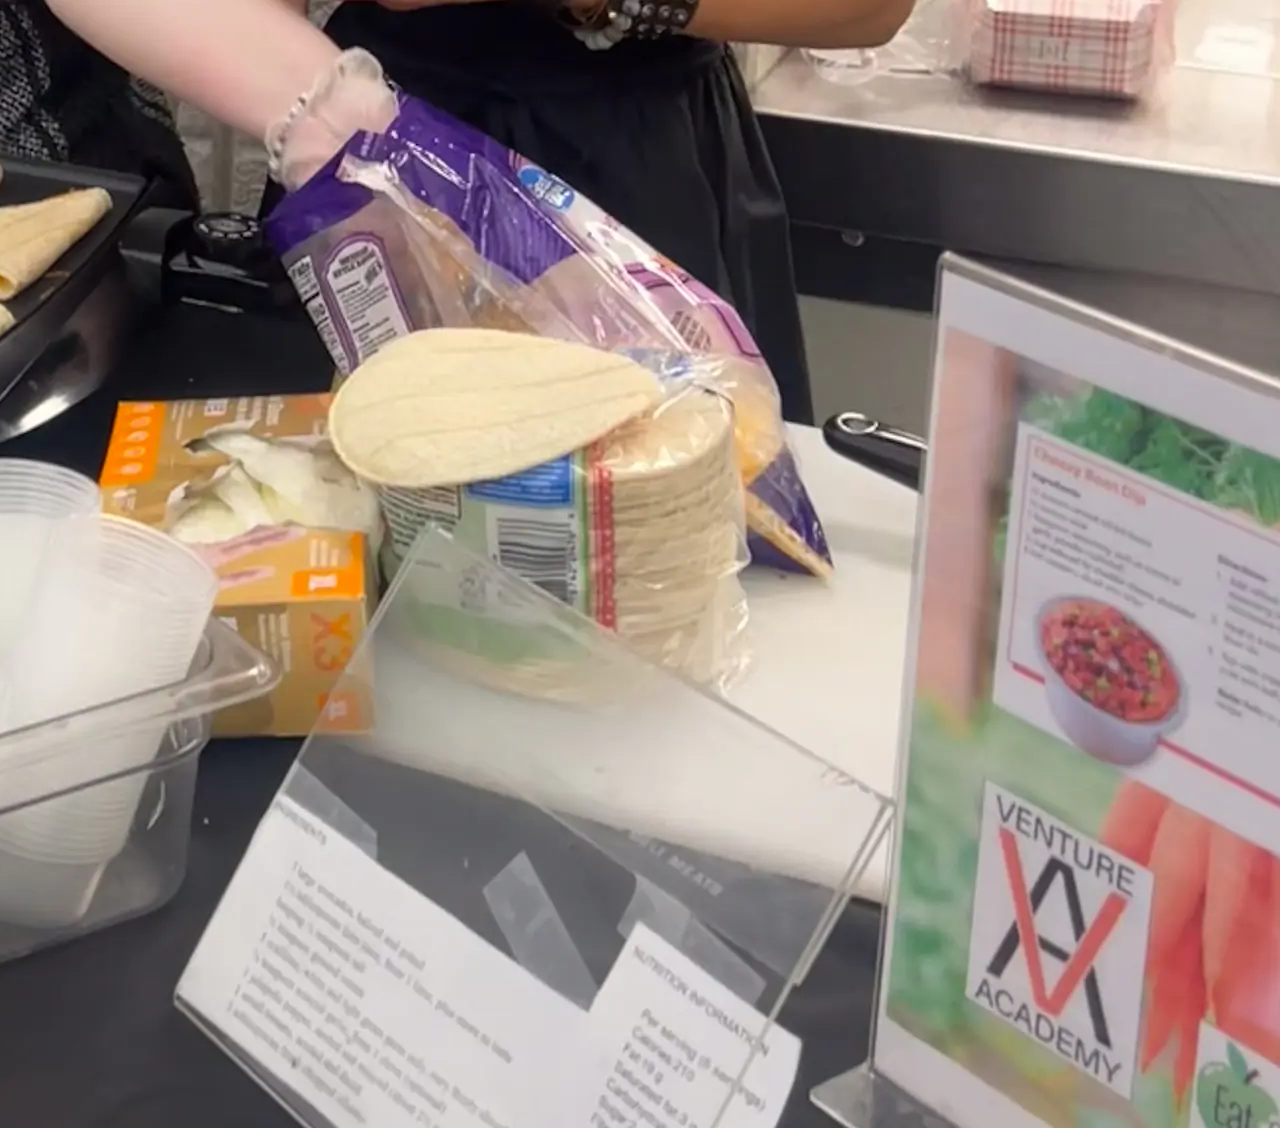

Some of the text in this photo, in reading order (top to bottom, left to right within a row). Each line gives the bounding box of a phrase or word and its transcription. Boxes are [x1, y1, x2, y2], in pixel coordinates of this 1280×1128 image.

[995, 794, 1136, 898] VENTURE
[633, 945, 689, 996] NUTRITION
[974, 978, 1122, 1085] ACADEMY
[1213, 1082, 1253, 1128] Eat
